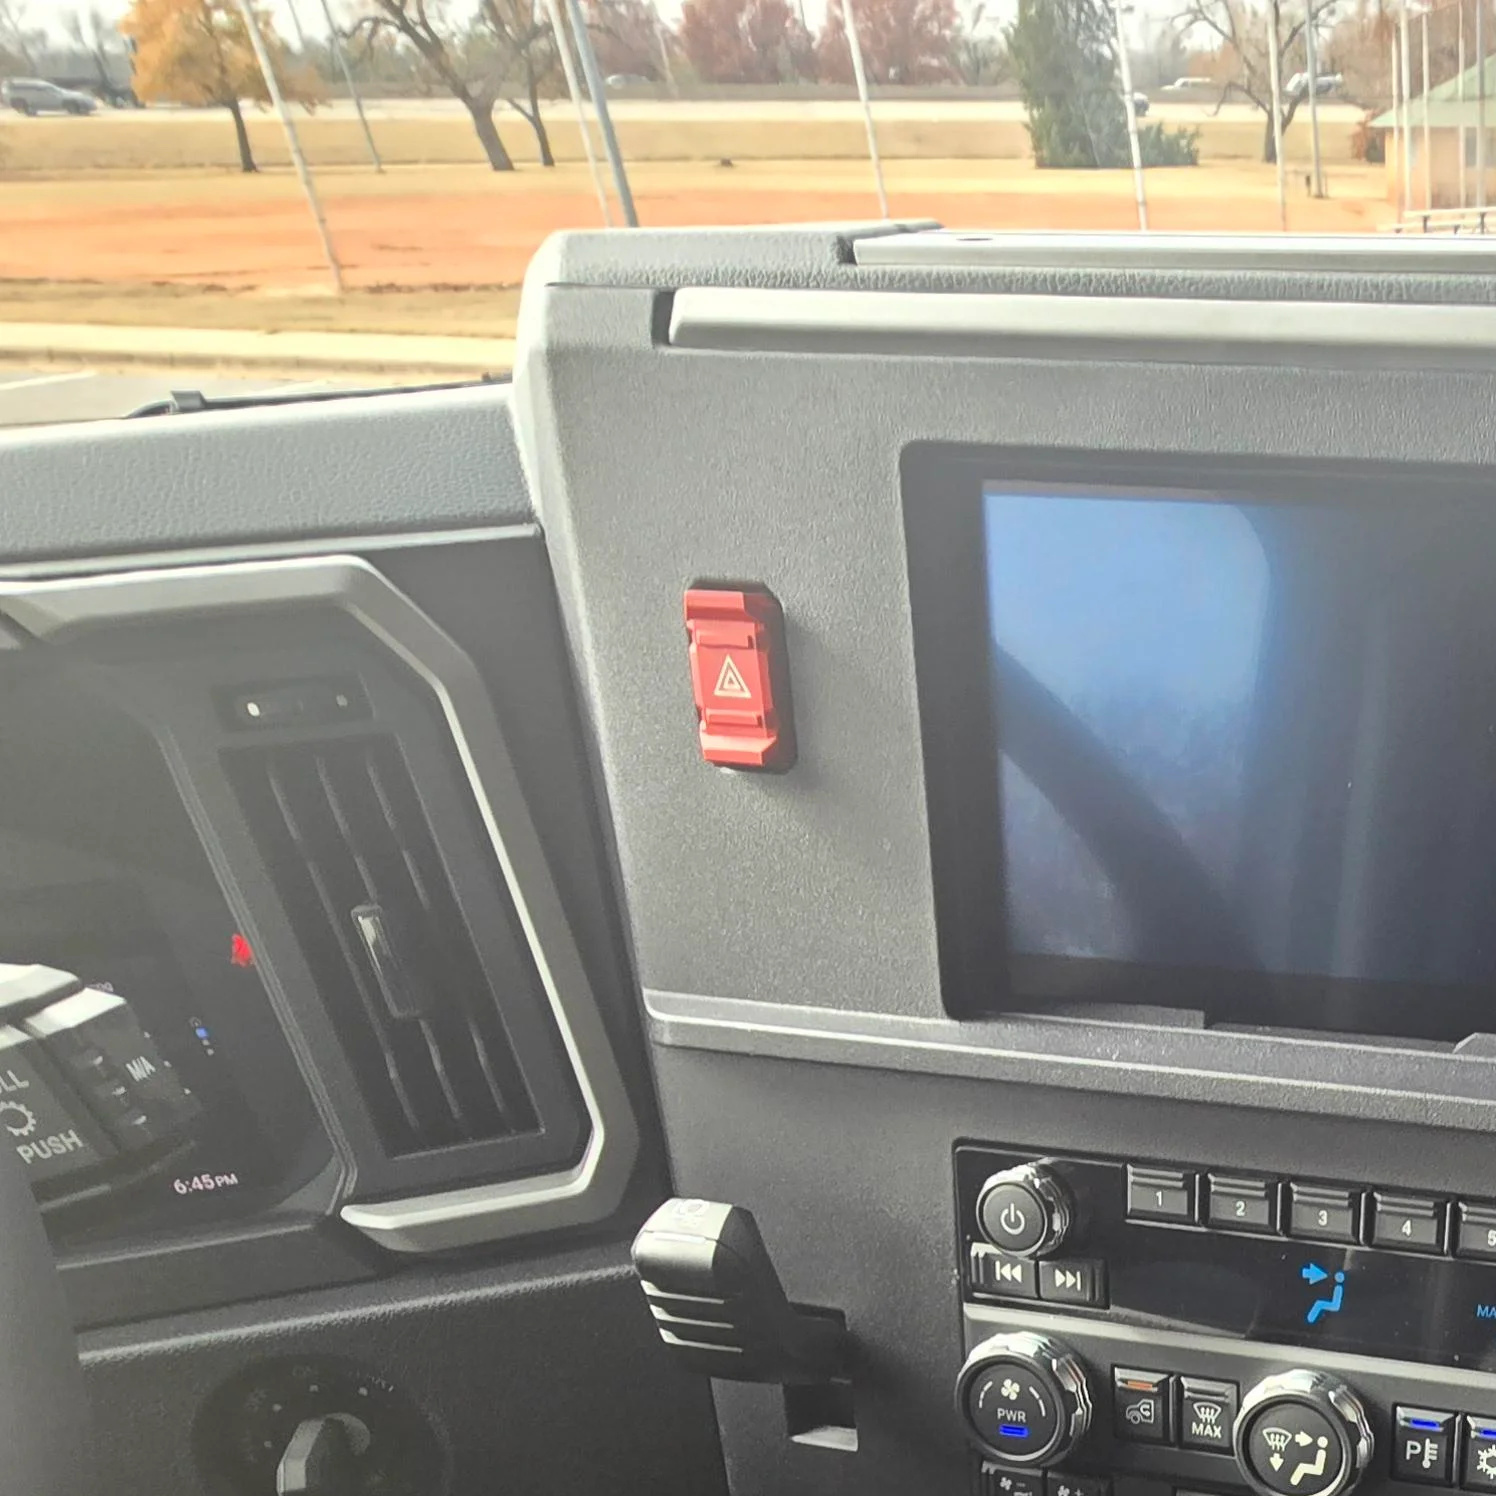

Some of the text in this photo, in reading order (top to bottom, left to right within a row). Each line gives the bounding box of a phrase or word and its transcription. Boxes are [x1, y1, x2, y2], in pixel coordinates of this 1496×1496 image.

[16, 1129, 84, 1164] PUSH
[1155, 1190, 1164, 1207] 1
[1235, 1201, 1247, 1218] 2
[1317, 1210, 1329, 1227] 3
[1401, 1219, 1413, 1237] 4
[997, 1407, 1027, 1423] PWR
[1191, 1422, 1222, 1439] MAX
